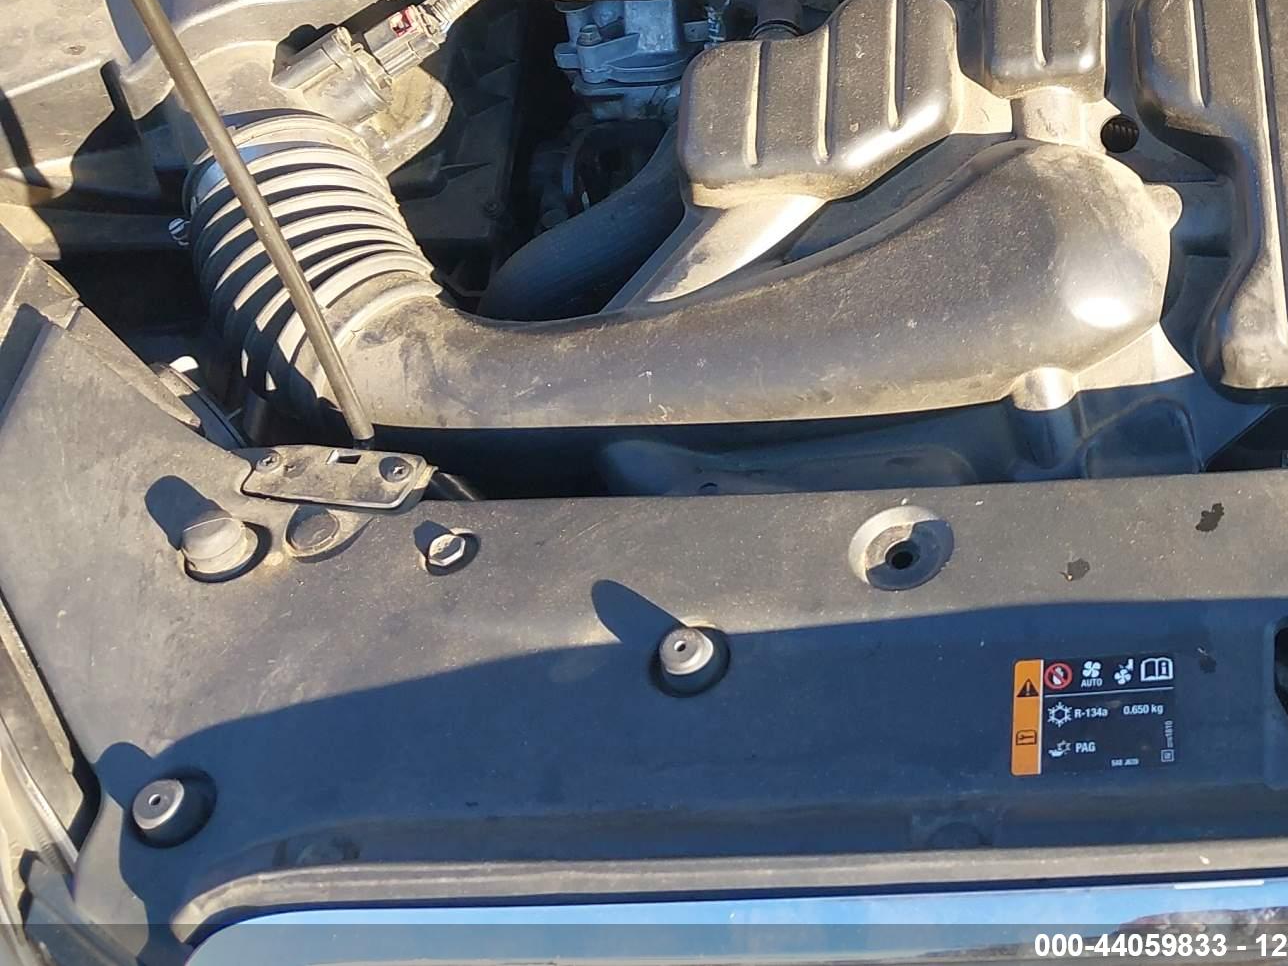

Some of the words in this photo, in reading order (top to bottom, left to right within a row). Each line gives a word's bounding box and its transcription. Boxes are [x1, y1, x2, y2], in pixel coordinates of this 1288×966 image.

[1080, 678, 1103, 688] AUTO
[1074, 707, 1109, 719] R-134a
[1123, 705, 1150, 715] 0.650
[1151, 703, 1164, 715] kg
[1075, 742, 1096, 753] PAG
